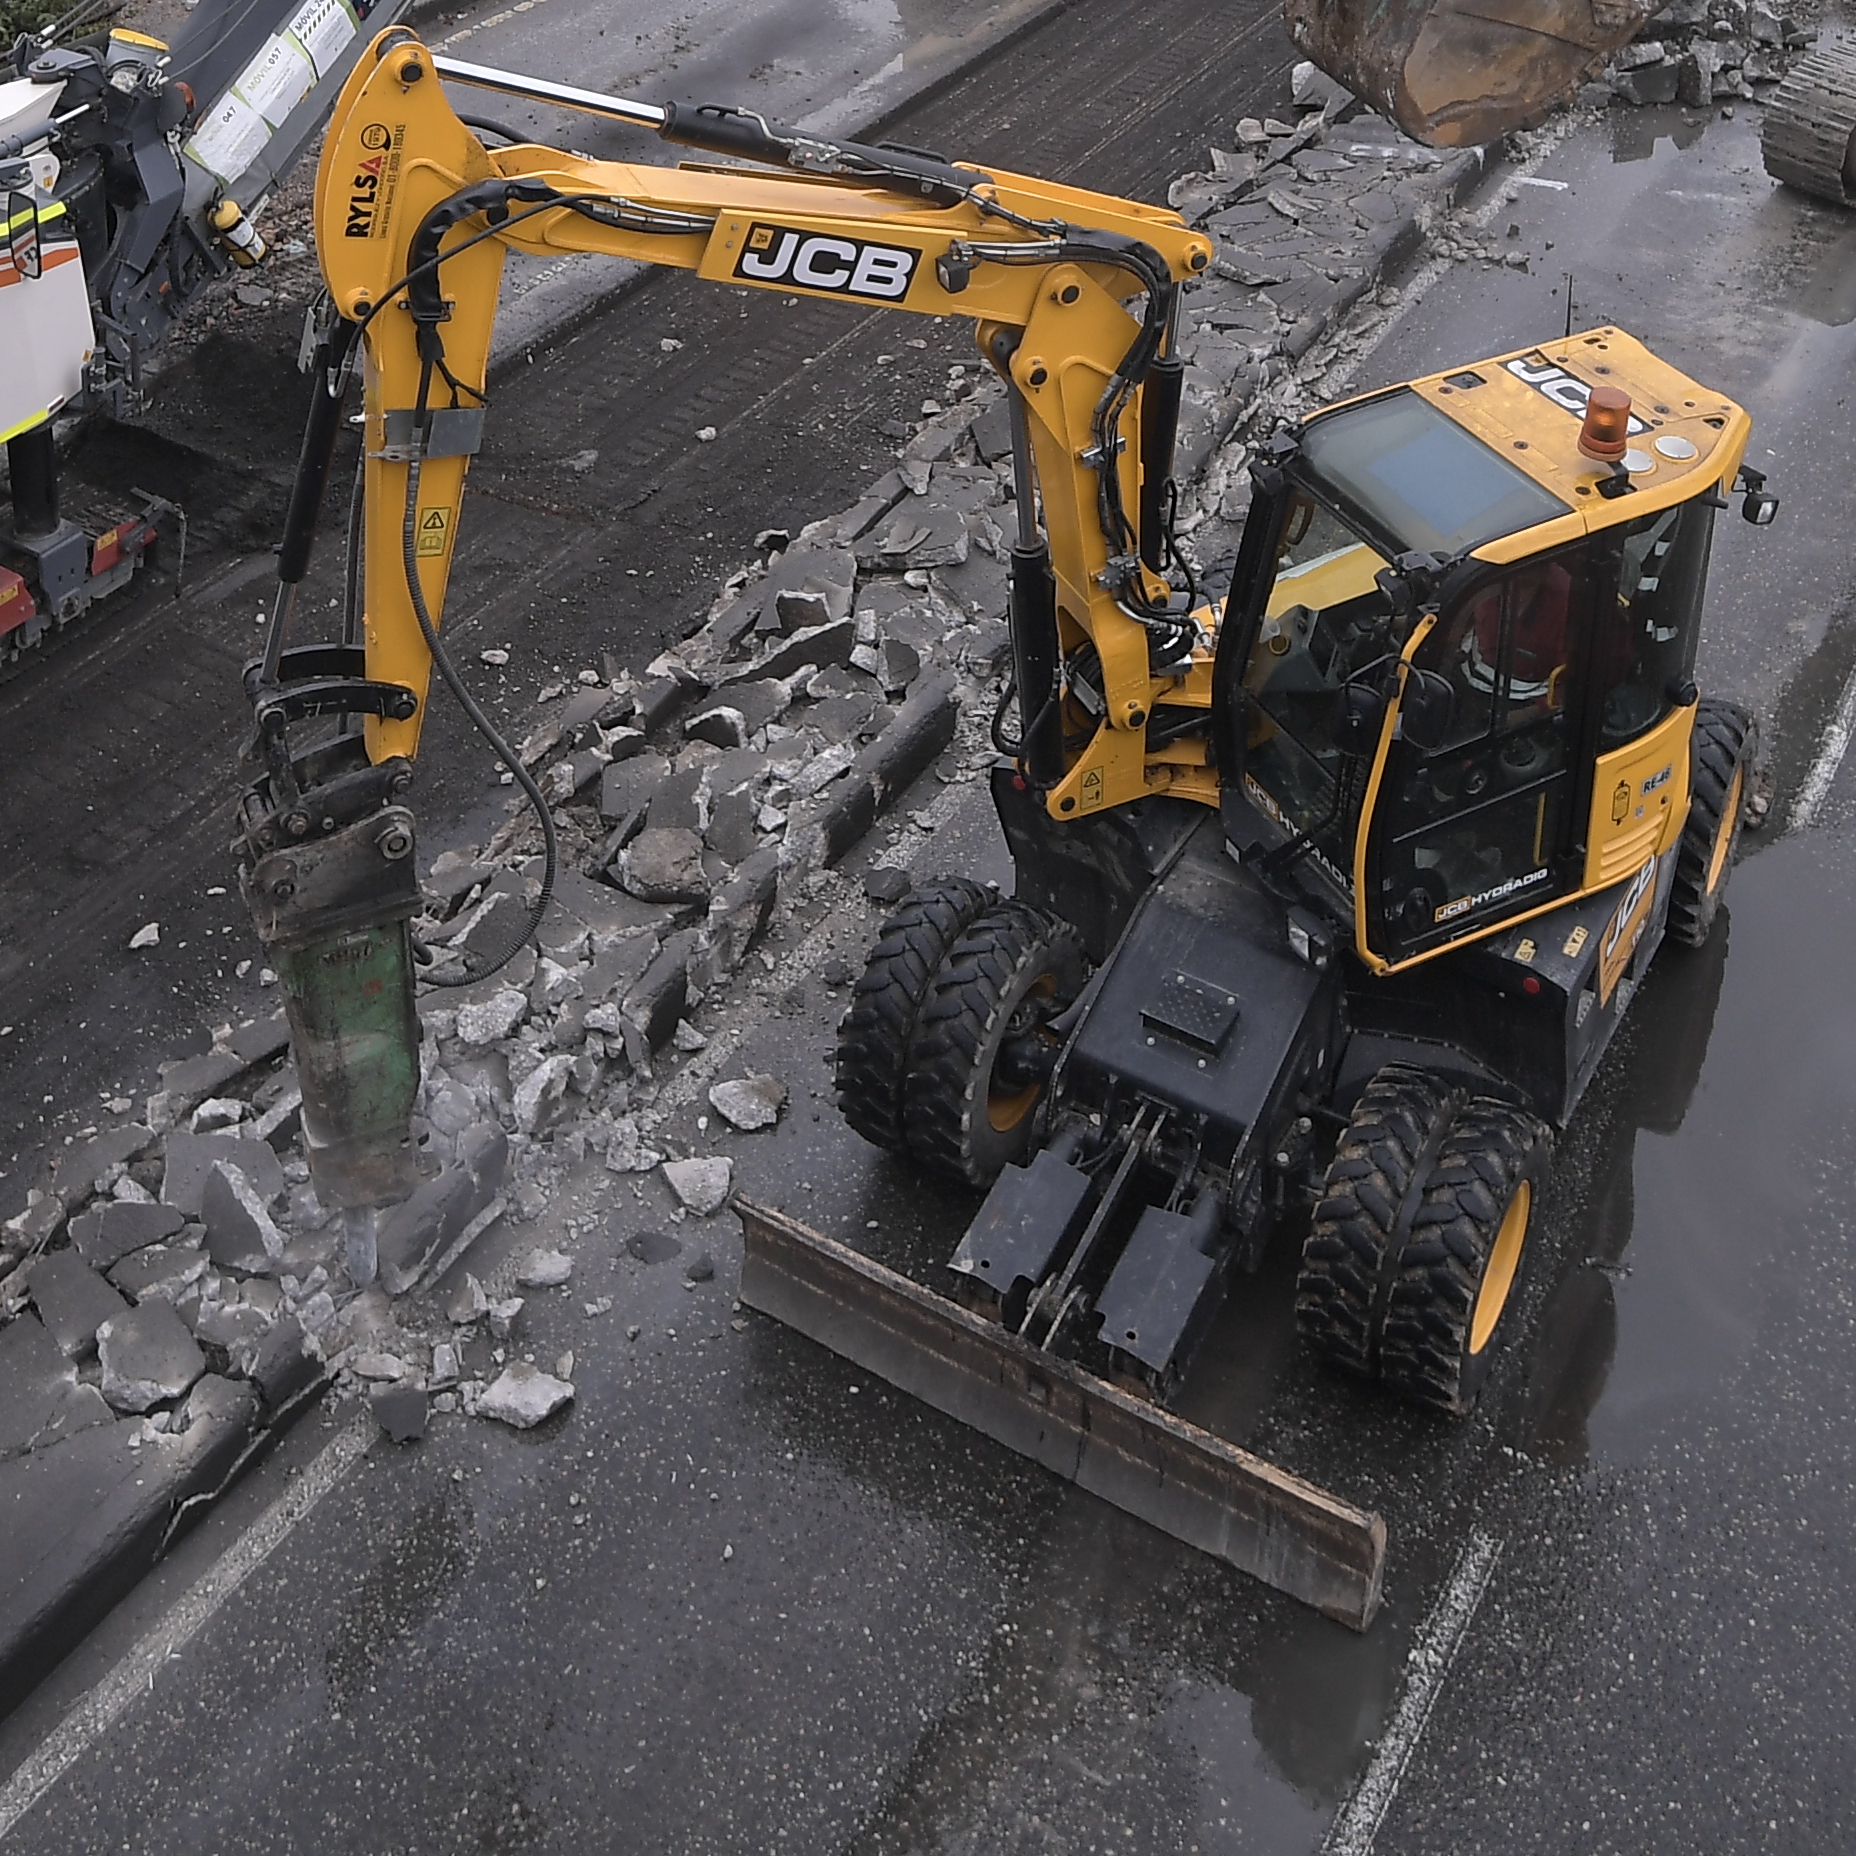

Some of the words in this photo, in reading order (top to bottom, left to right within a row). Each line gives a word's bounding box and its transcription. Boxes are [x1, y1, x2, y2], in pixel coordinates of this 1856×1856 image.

[294, 8, 318, 33] MÓVIL
[267, 47, 282, 66] 057
[221, 106, 238, 124] 047
[345, 155, 382, 237] RYLSA
[742, 232, 913, 296] JCB
[1438, 898, 1471, 921] JCB
[1472, 868, 1548, 904] HYDRADIG
